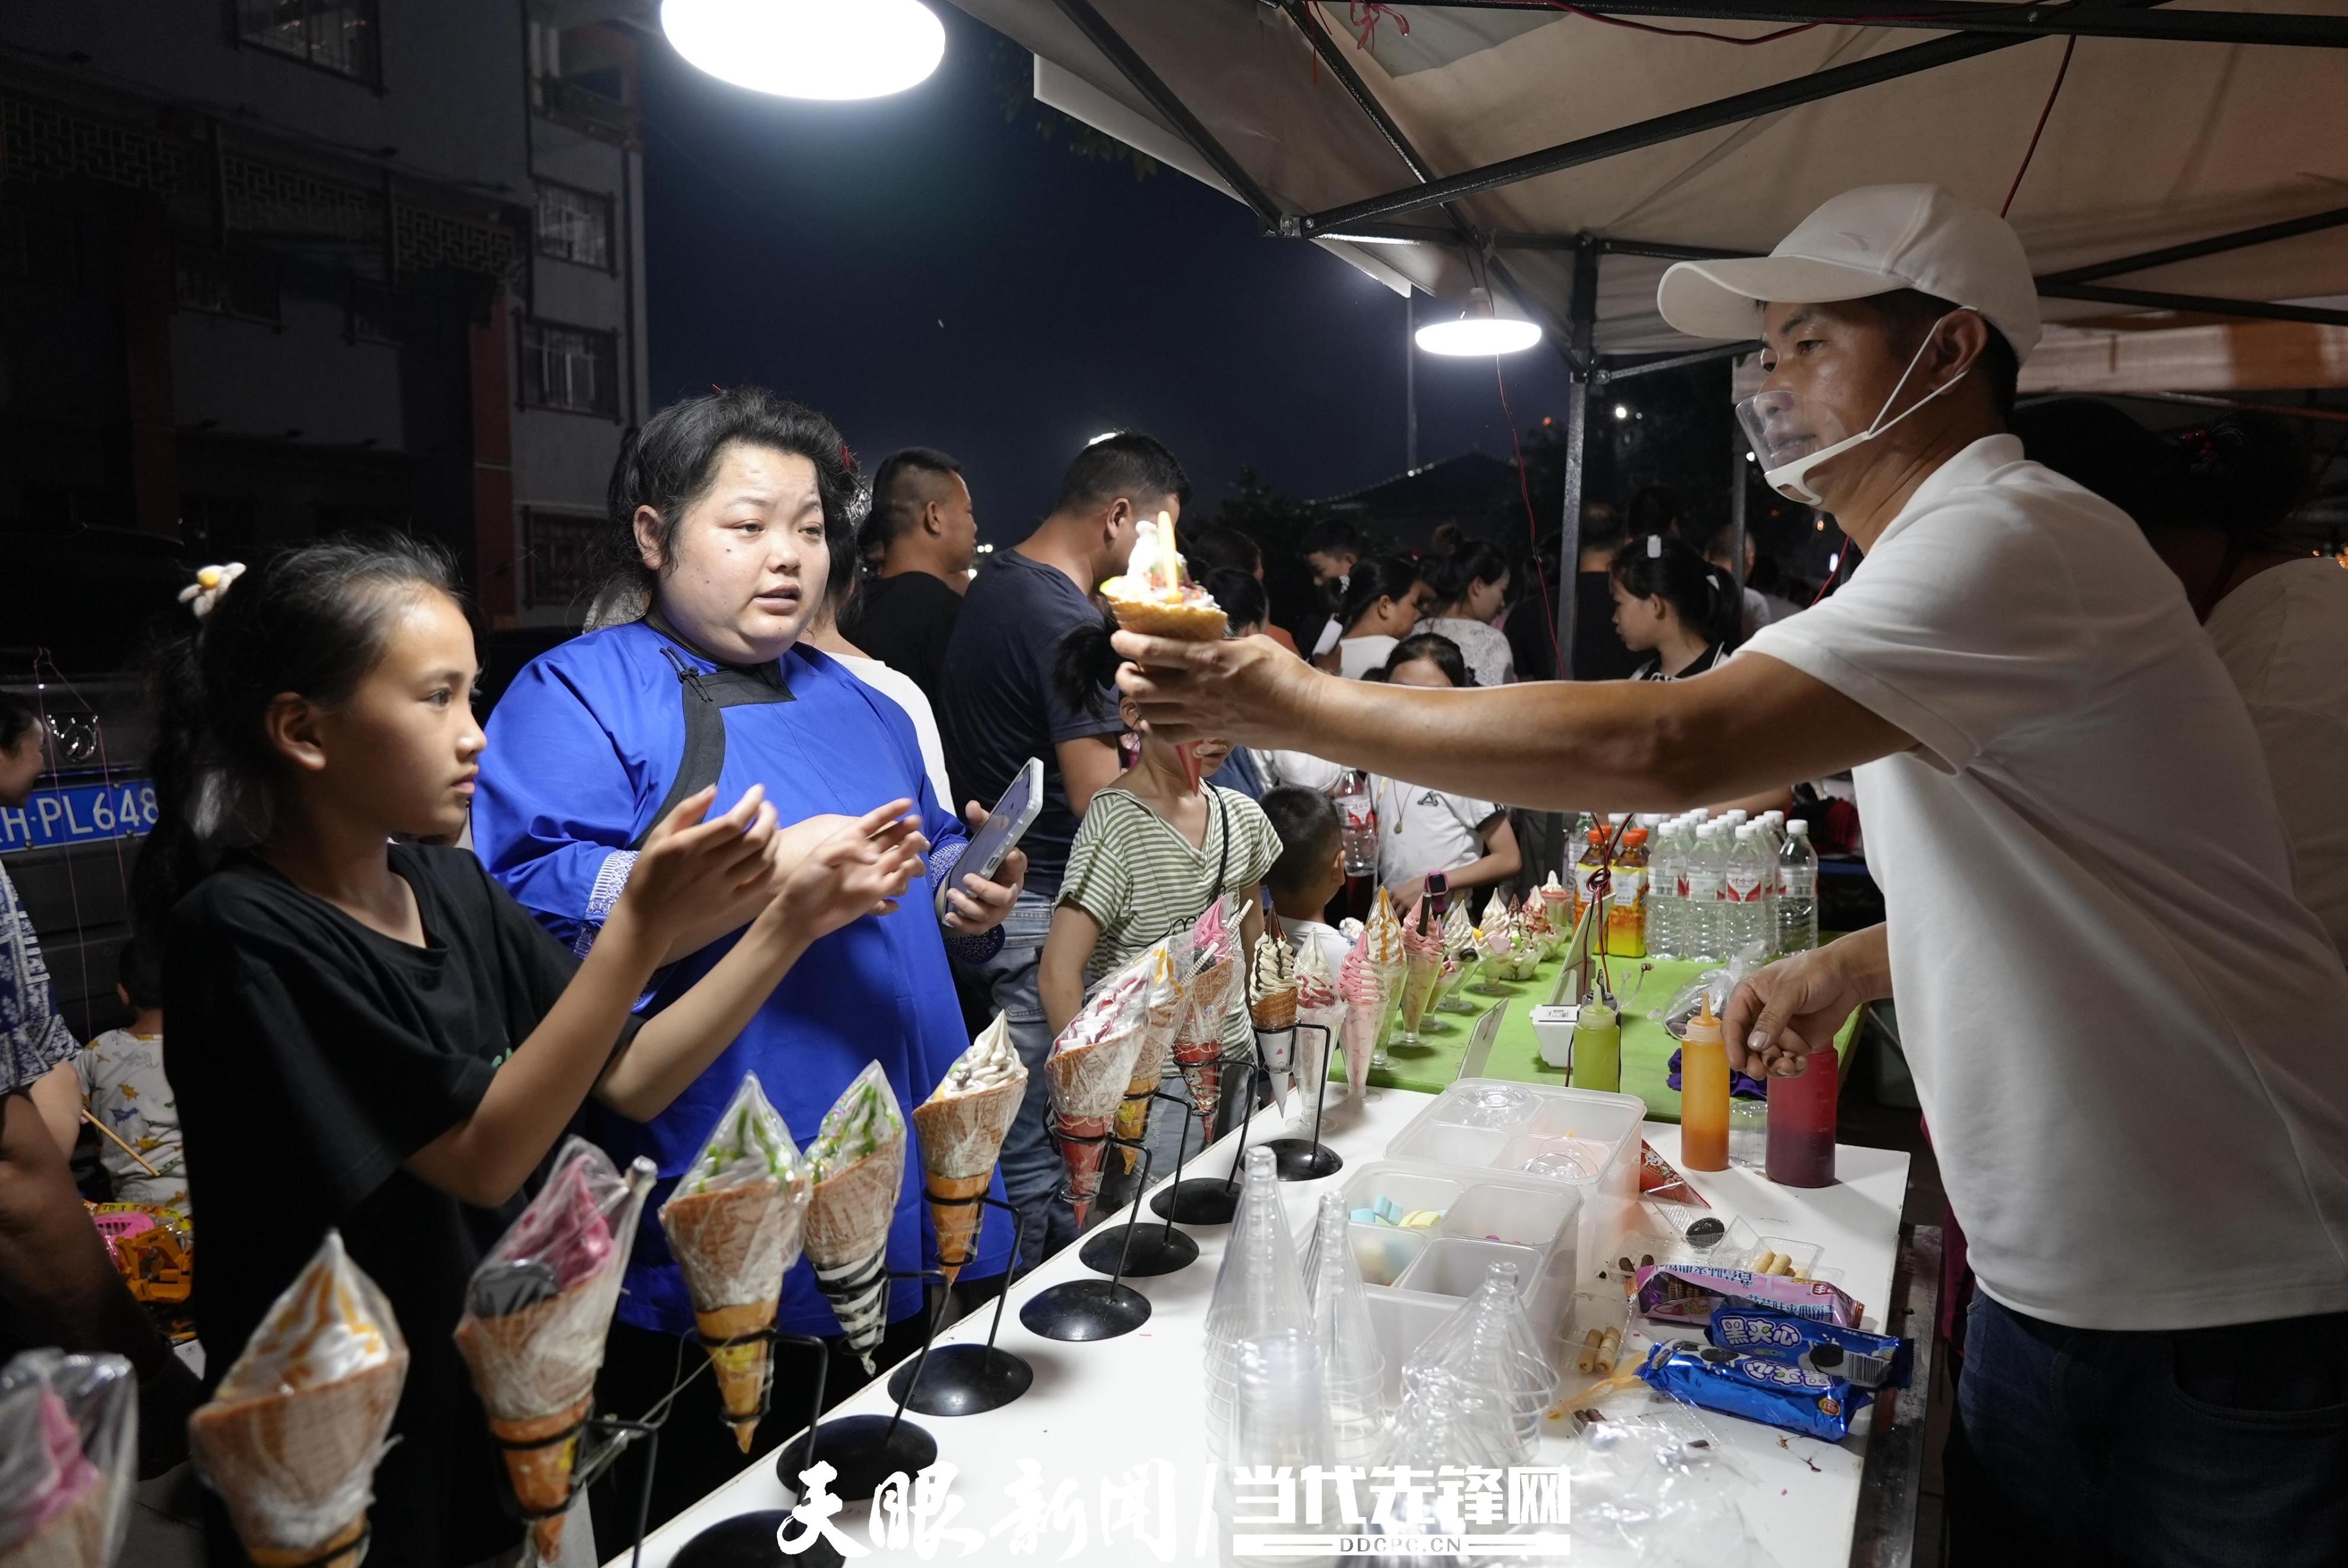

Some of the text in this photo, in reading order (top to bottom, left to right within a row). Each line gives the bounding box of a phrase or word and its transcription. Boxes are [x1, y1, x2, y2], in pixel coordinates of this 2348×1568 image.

[0, 787, 159, 842] H·PL648
[1720, 1316, 1802, 1348] 黑夹心
[1744, 1361, 1834, 1388] 黑夹心
